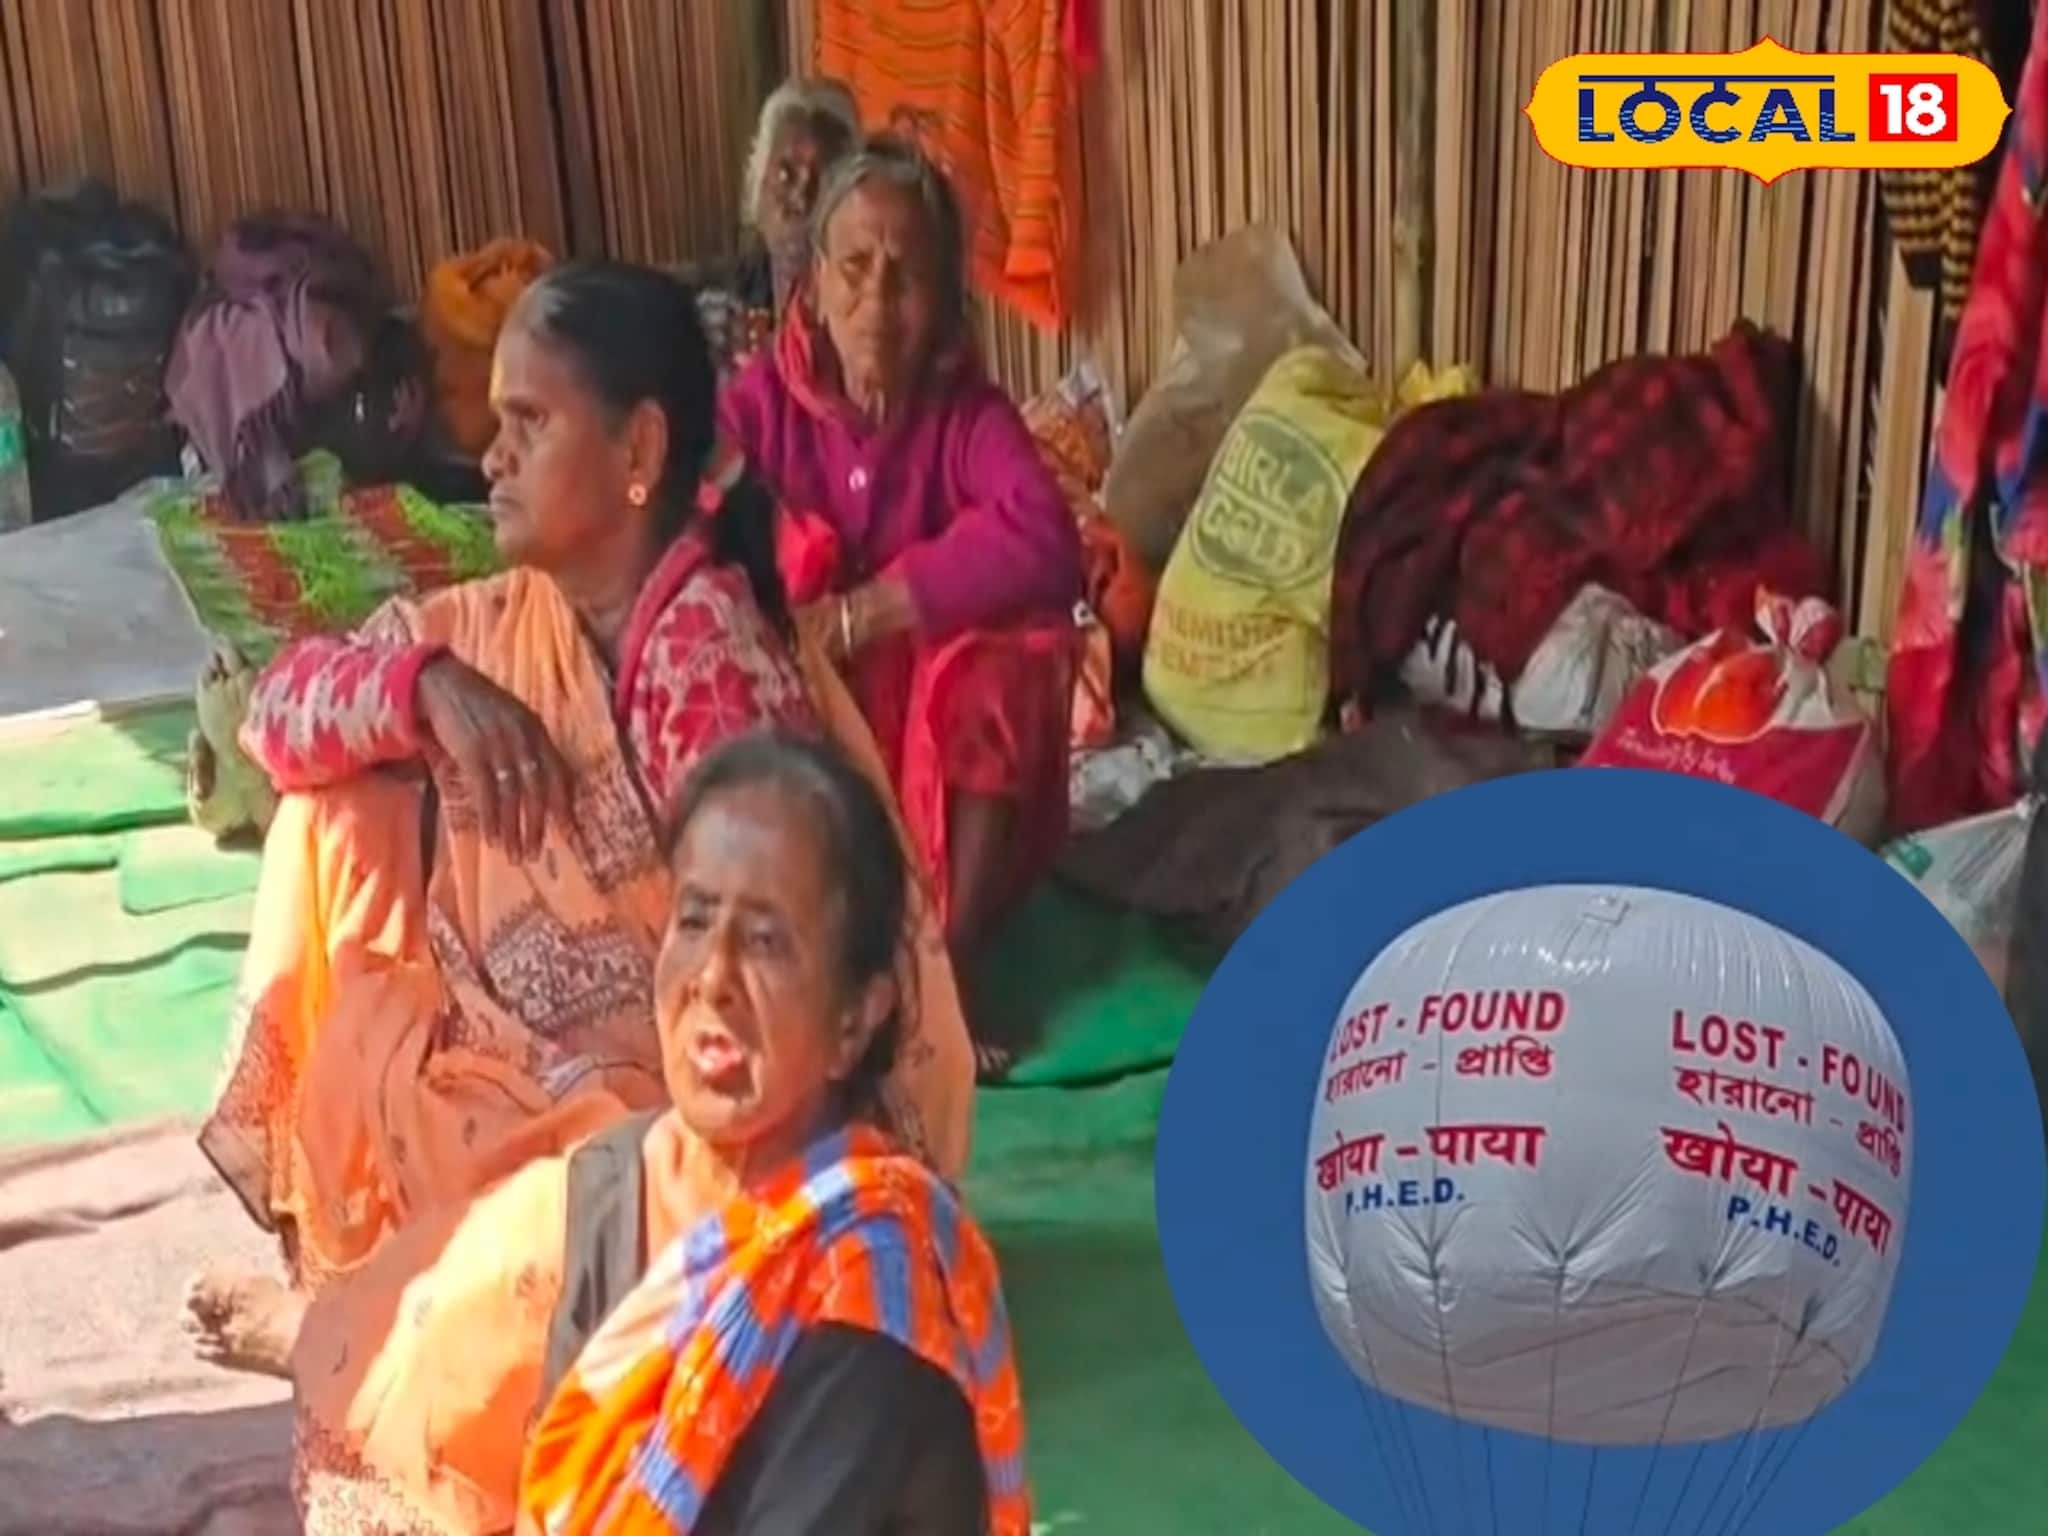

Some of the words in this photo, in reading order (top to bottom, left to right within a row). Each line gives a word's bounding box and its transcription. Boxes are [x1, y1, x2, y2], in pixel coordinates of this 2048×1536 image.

[1222, 429, 1326, 528] BIRLA
[1203, 494, 1302, 575] GOLD
[1417, 991, 1564, 1034] FOUND
[1672, 1009, 1785, 1069] LOST
[1673, 1066, 1815, 1126] হারানো
[1424, 1124, 1546, 1167] पाया
[1660, 1120, 1798, 1197] खोया
[1833, 1179, 1892, 1256] पाया
[1727, 1196, 1841, 1266] P.H.E.D.
